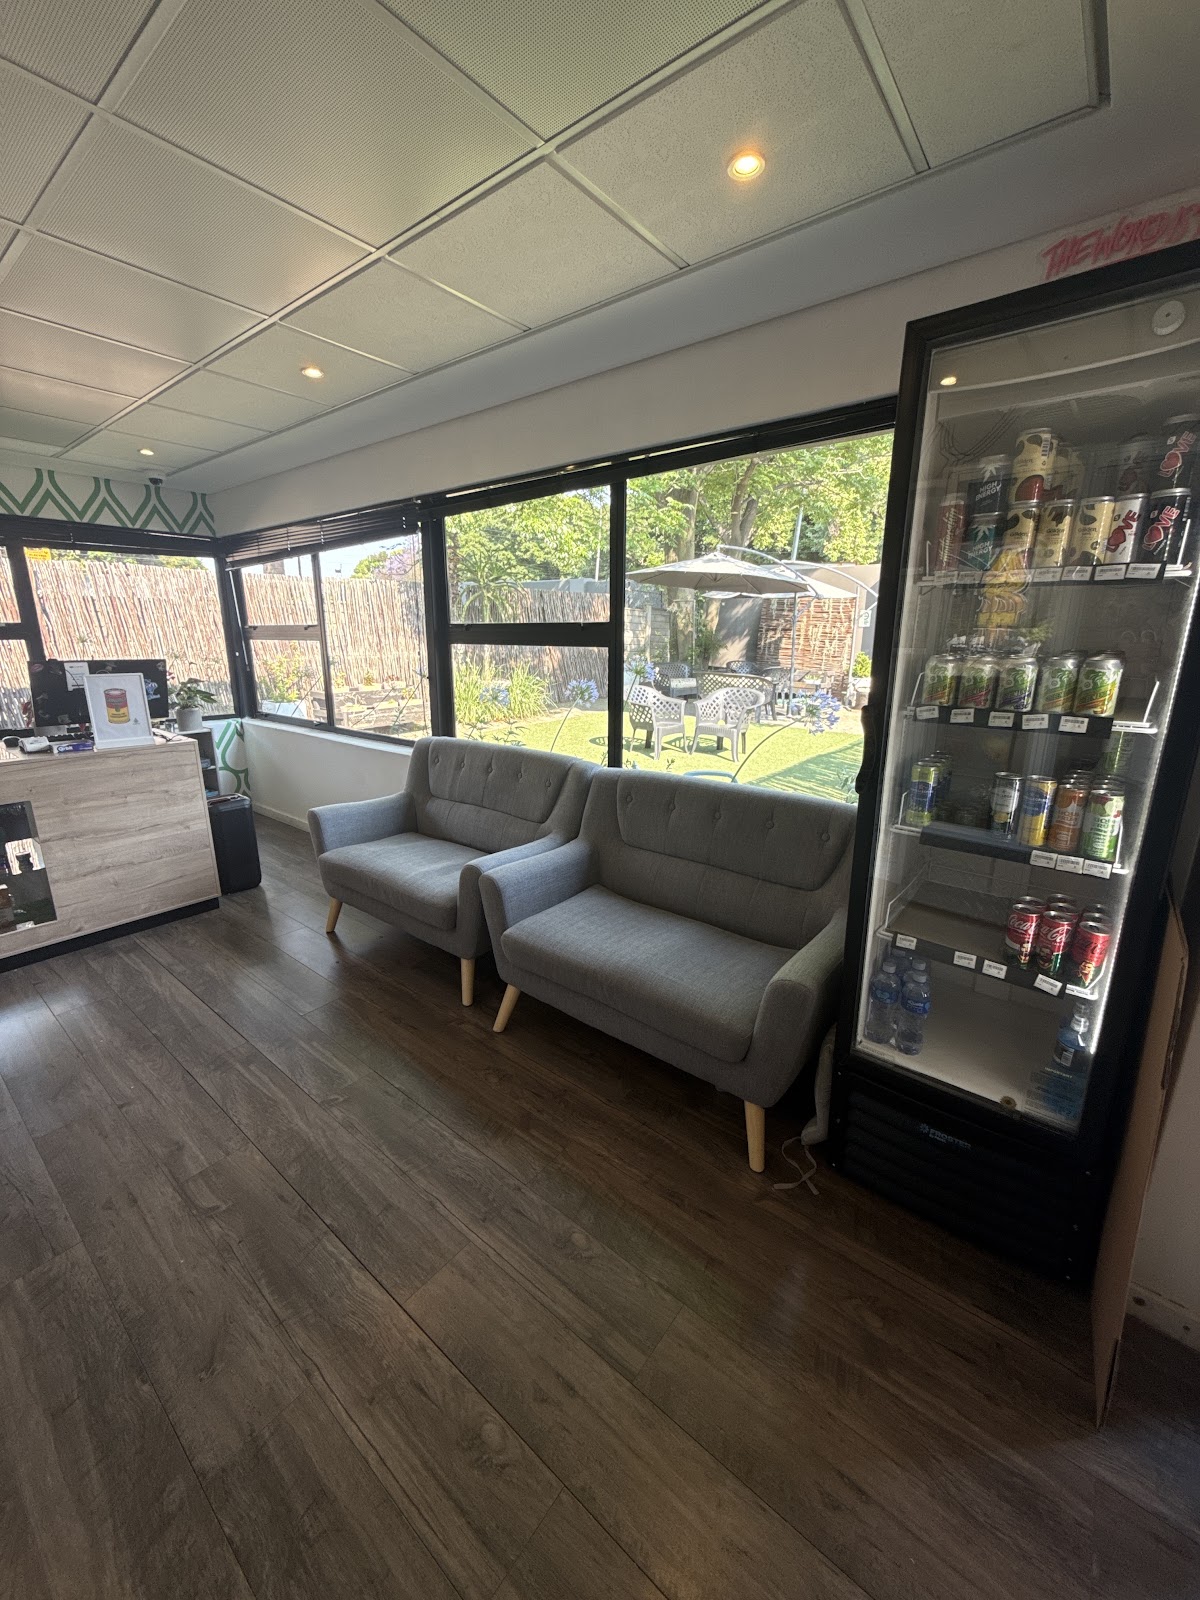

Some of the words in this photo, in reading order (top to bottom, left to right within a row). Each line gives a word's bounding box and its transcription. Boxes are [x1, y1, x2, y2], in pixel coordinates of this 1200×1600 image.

[975, 484, 1001, 501] ENERGY
[980, 481, 998, 493] HIGH
[1106, 510, 1141, 553] LOVE
[1142, 506, 1180, 551] LOVE
